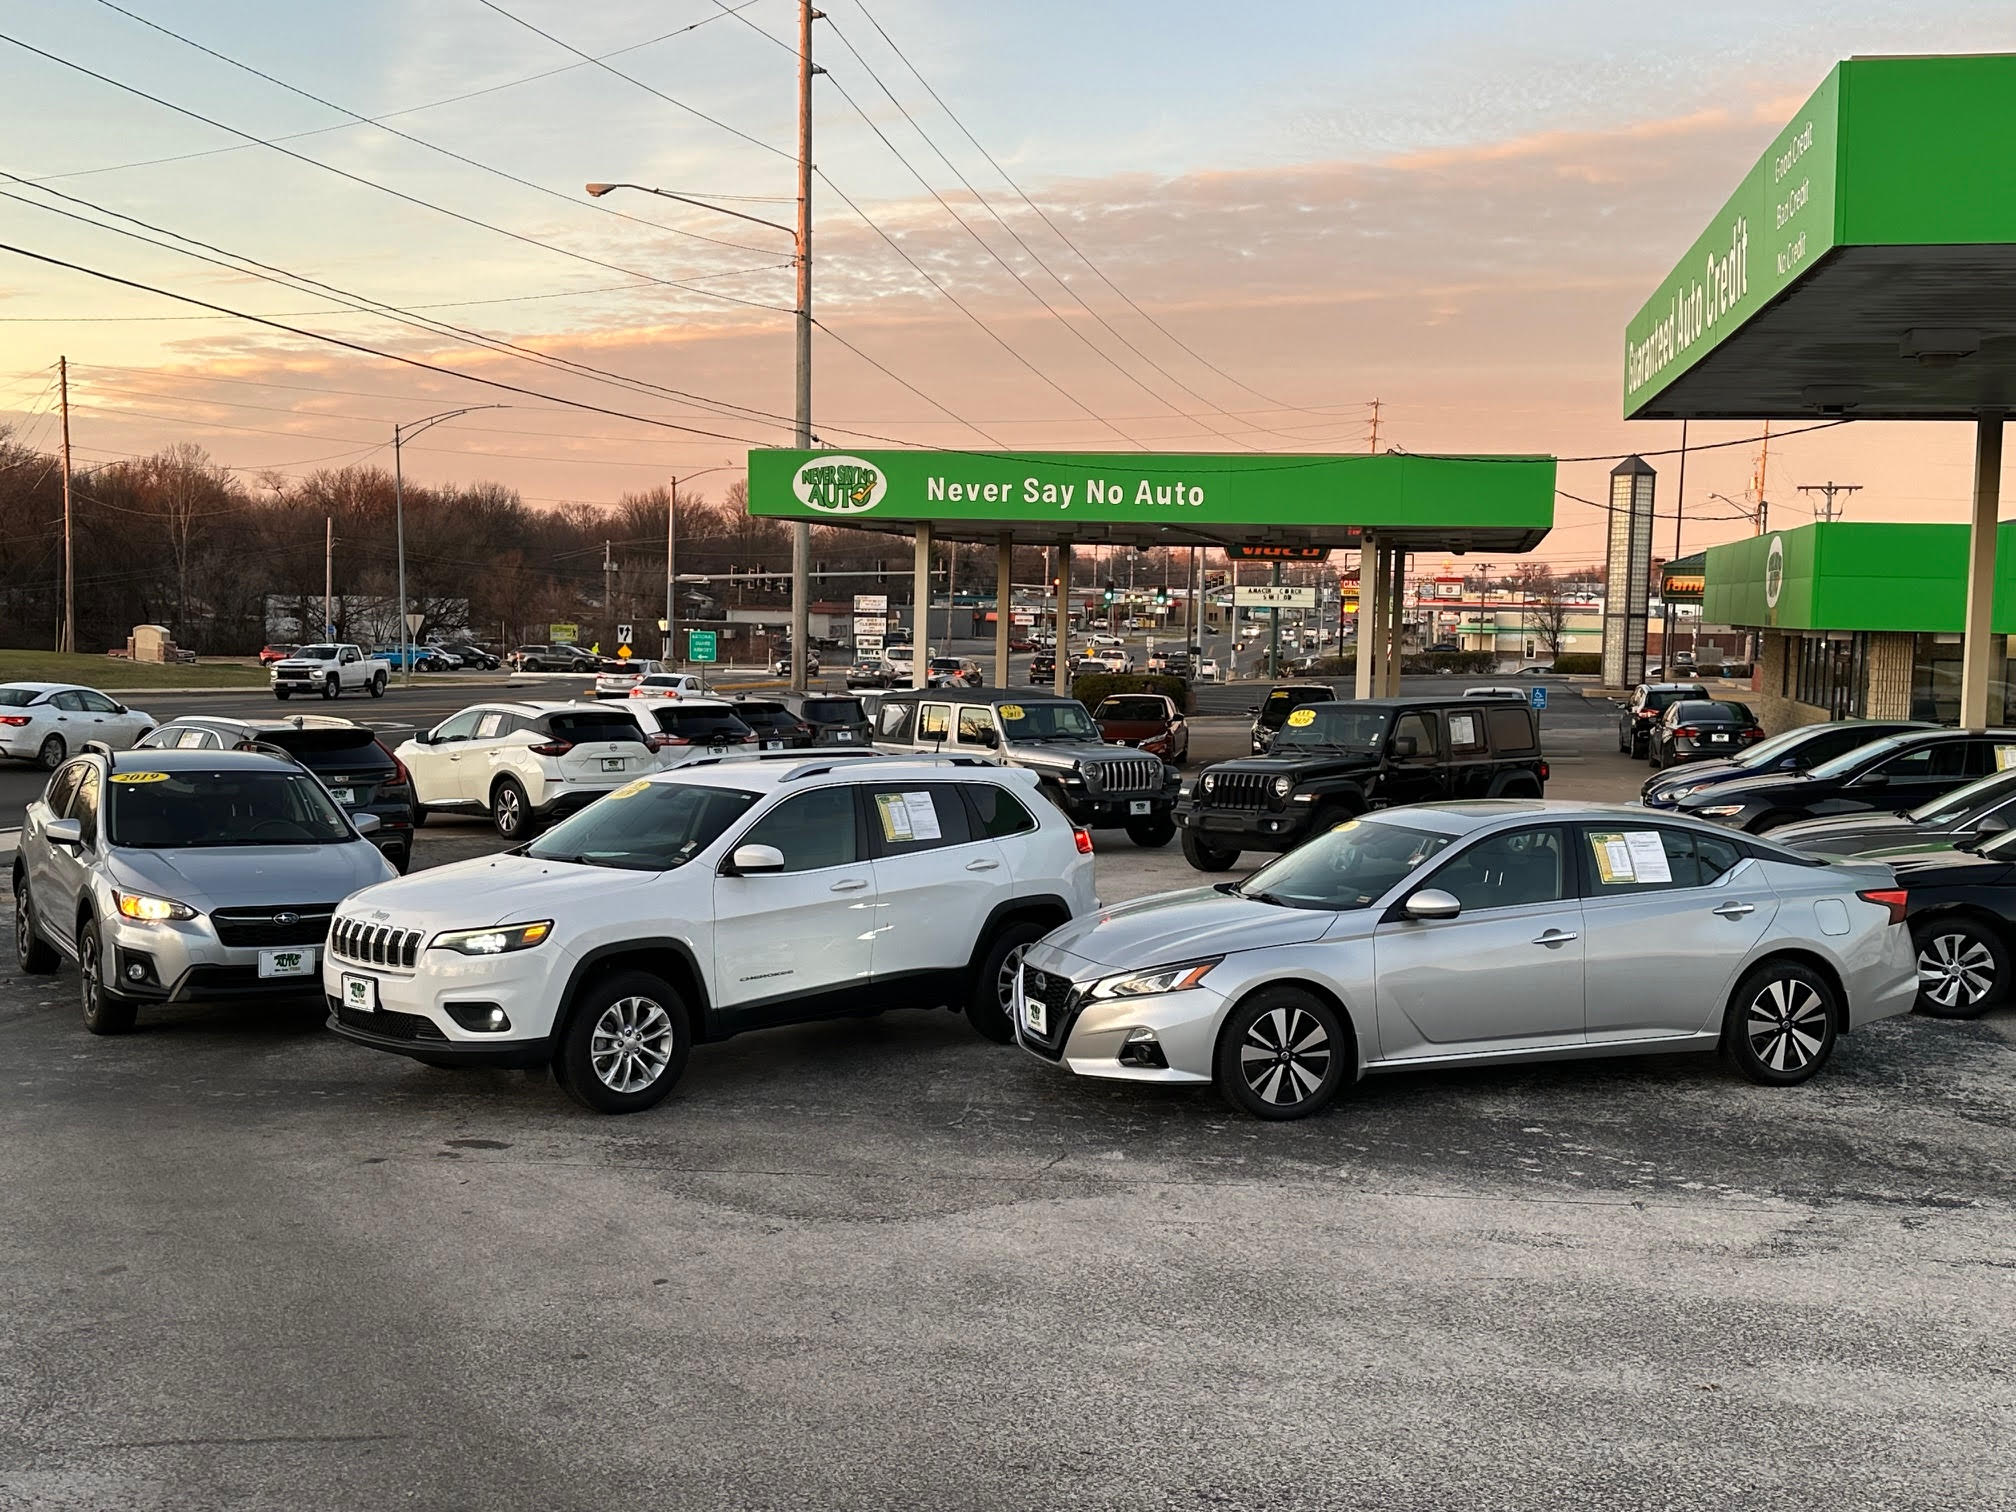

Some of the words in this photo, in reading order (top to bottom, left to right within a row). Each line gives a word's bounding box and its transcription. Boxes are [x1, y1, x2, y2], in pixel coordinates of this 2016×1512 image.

[1775, 142, 1791, 184] Good
[1792, 120, 1813, 165] Credit
[1776, 195, 1789, 230] Bad
[1790, 176, 1809, 218] Credit
[1776, 251, 1787, 277] No
[1787, 231, 1806, 269] Credit
[1628, 296, 1675, 396] Guaranteed
[1676, 279, 1703, 358] Auto
[1706, 214, 1748, 329] Credit
[801, 465, 837, 485] NEVER
[836, 464, 857, 485] SAY
[856, 465, 878, 485] NO
[927, 477, 1012, 503] Never
[1023, 477, 1075, 510] Say
[1086, 479, 1124, 505] No
[1134, 480, 1204, 506] Auto
[808, 483, 872, 509] AUTO
[119, 772, 160, 782] 2019
